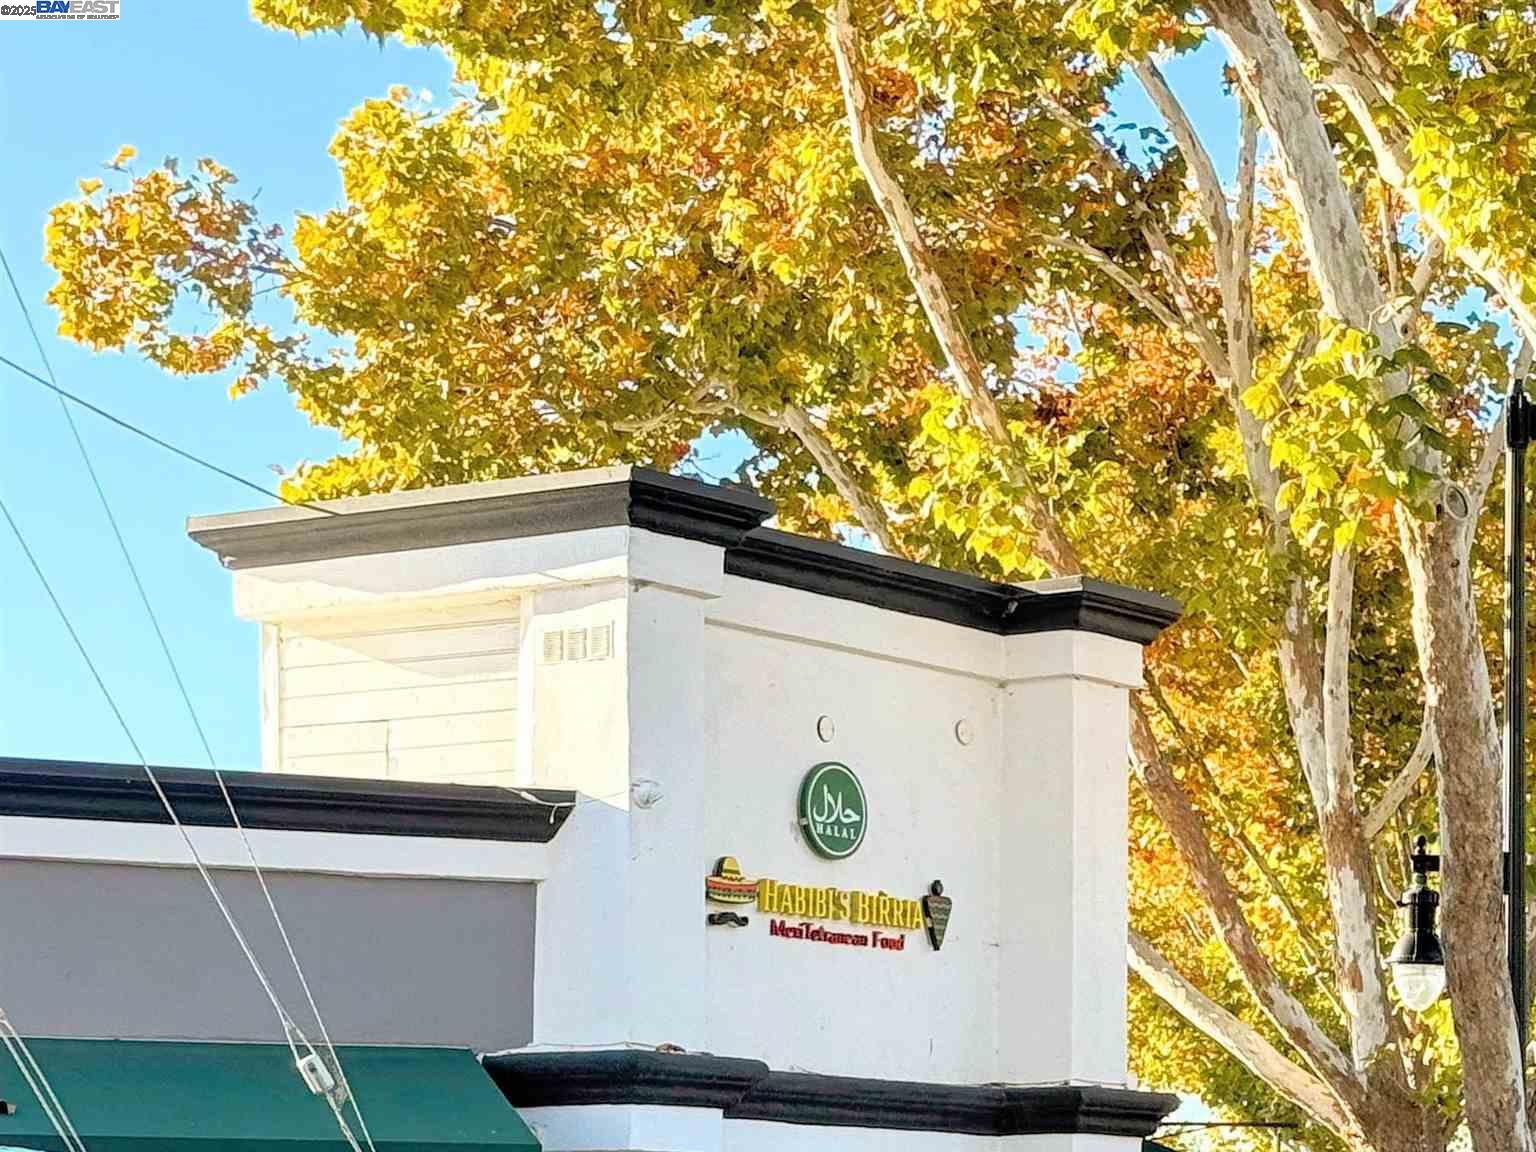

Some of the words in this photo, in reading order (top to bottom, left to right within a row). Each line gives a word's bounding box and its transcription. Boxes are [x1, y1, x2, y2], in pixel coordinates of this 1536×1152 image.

[813, 784, 860, 823] حلال
[816, 823, 856, 840] HALAL
[852, 892, 924, 929] BIRRIA
